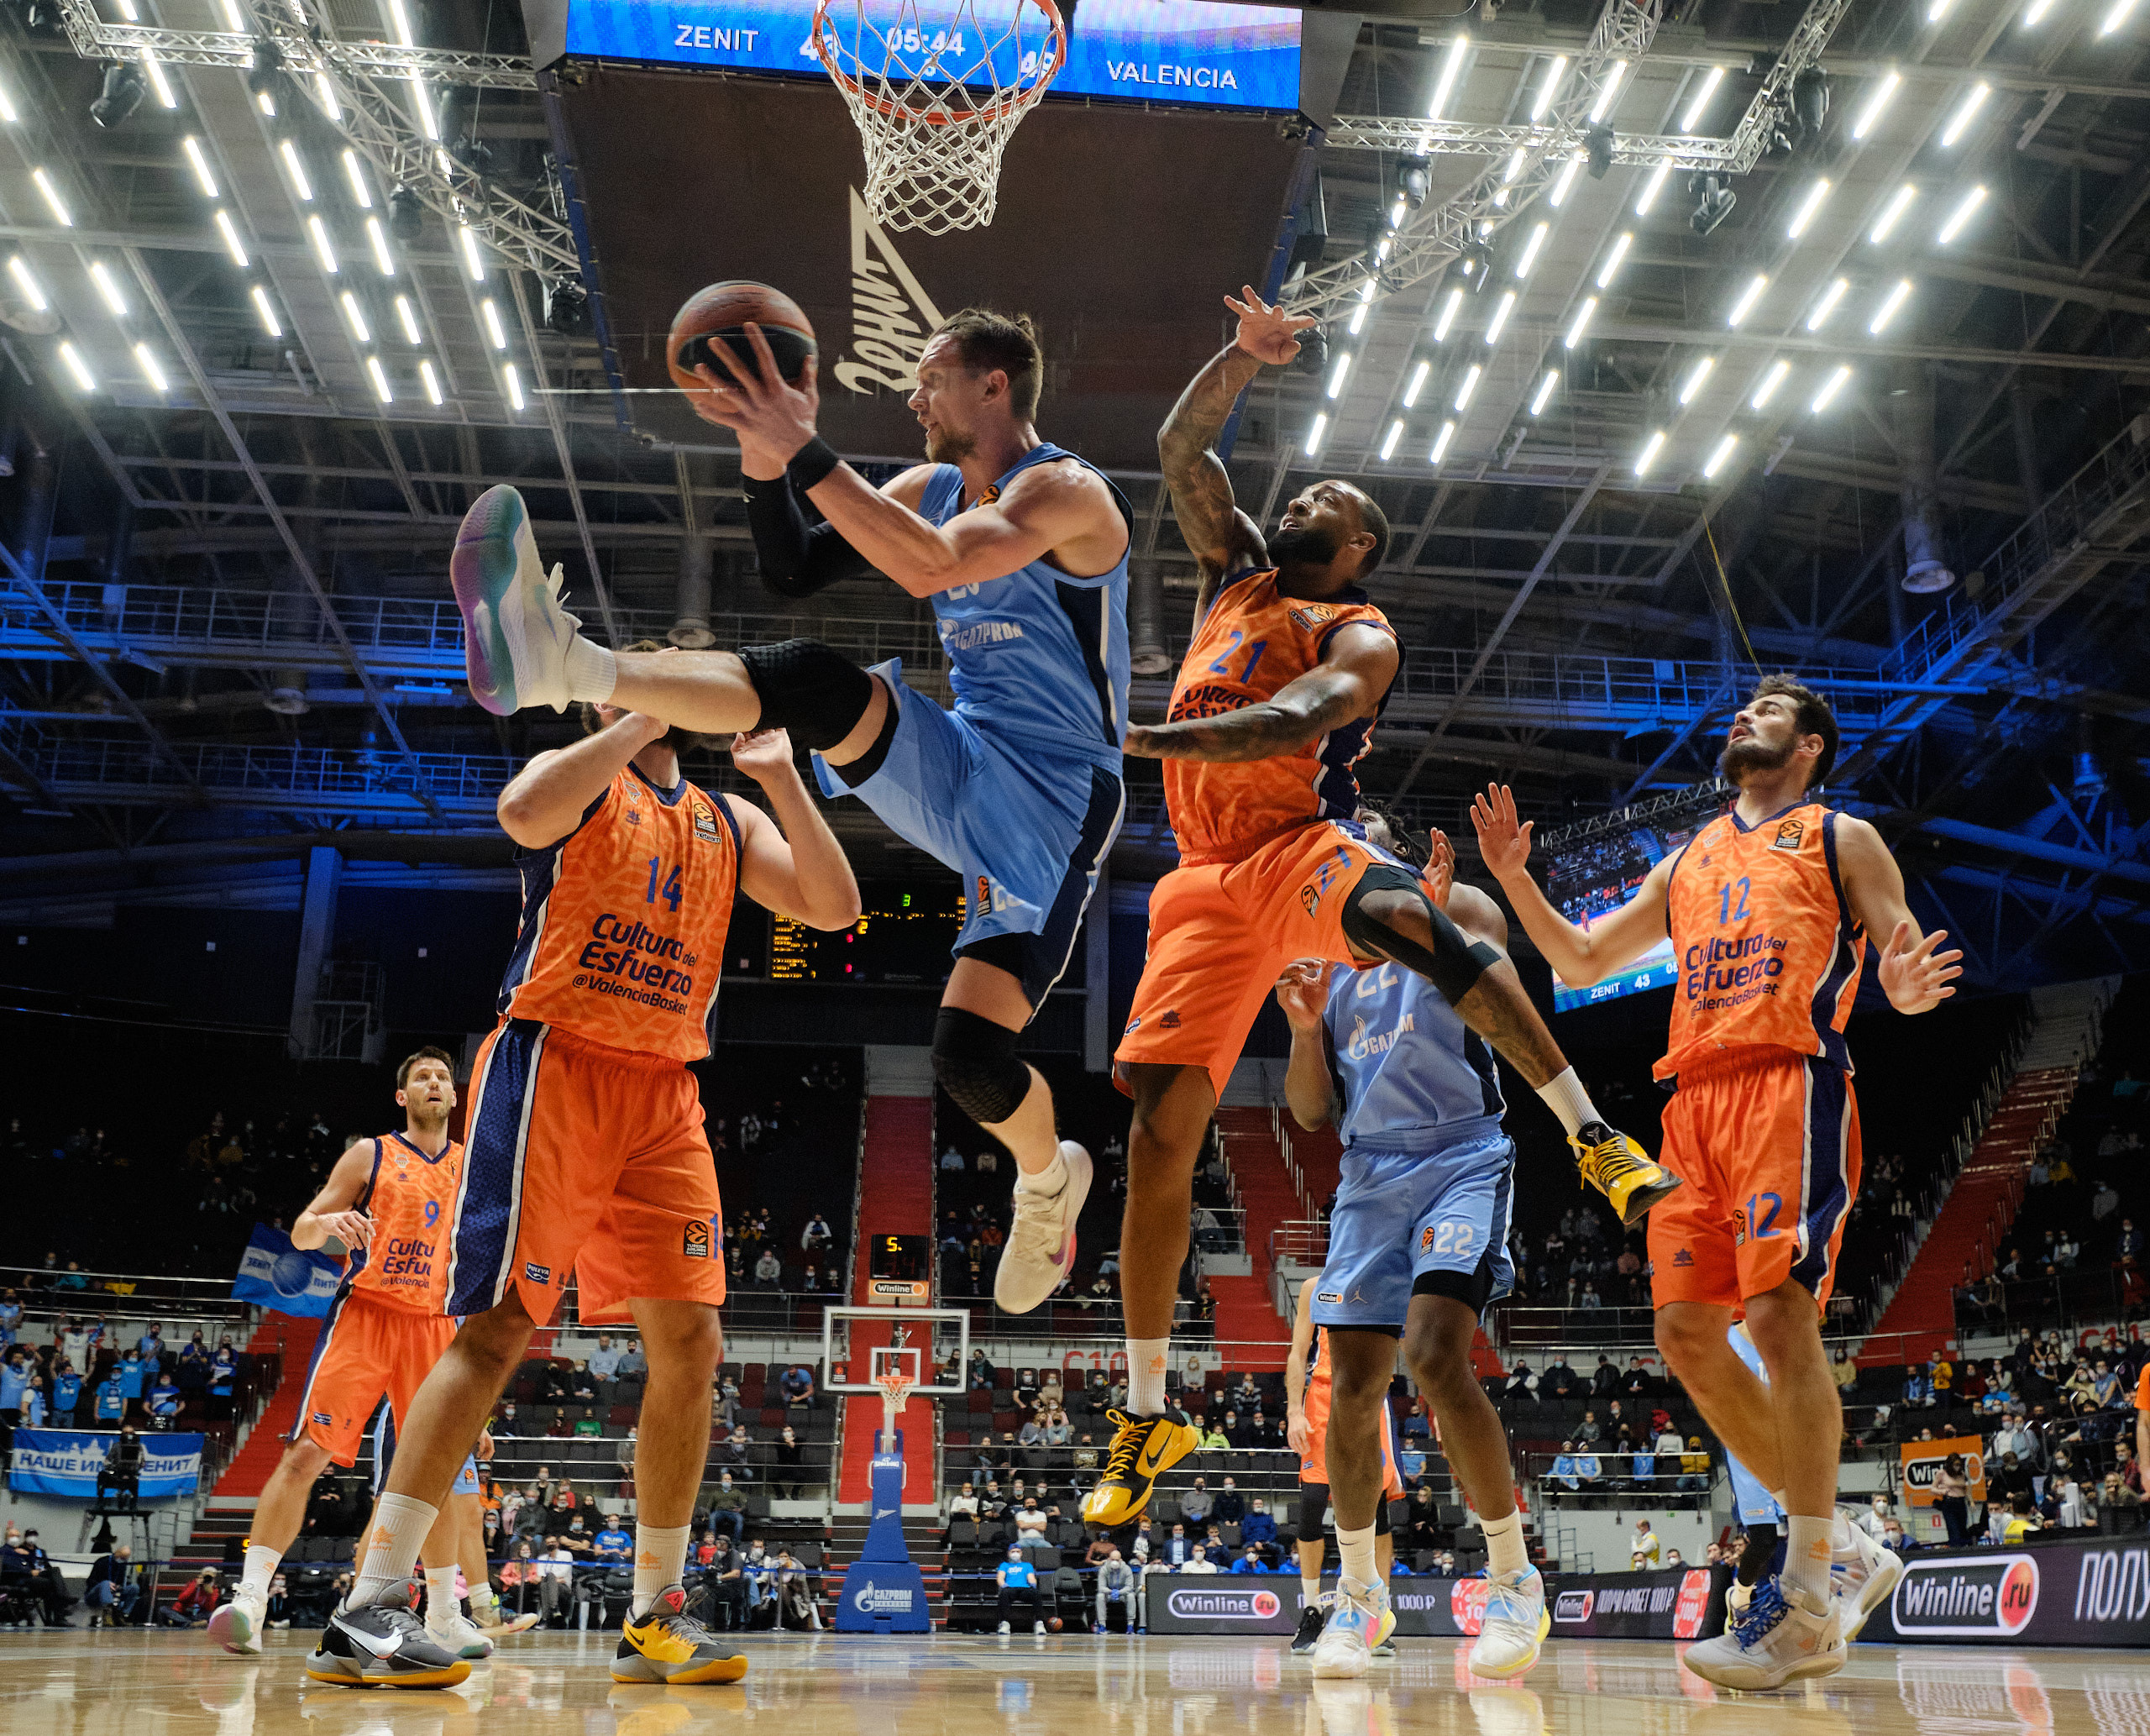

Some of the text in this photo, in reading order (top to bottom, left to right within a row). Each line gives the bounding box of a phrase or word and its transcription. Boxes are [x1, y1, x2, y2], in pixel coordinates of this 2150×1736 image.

[674, 24, 759, 52] ZENIT
[887, 27, 966, 56] 05:44
[1107, 60, 1239, 90] VALENCIA
[1209, 631, 1268, 684] 21
[646, 856, 682, 913] 14
[1719, 876, 1751, 925] 12
[592, 913, 699, 967] Cultura del
[1764, 936, 1788, 951] del
[579, 941, 693, 997] Esfuerzo
[1687, 957, 1785, 1000] Efuerzo
[572, 974, 689, 1015] @ValenciaBasket
[1591, 982, 1621, 999] ZENIT
[1634, 973, 1651, 989] 43
[424, 1200, 440, 1230] 9
[1745, 1192, 1783, 1240] 12
[388, 1238, 435, 1257] Cultu
[709, 1213, 724, 1260] 1
[1434, 1222, 1474, 1256] 22
[527, 1264, 549, 1275] PULEVA
[878, 1284, 910, 1293] Winline
[19, 1452, 77, 1471] НАШЕ
[144, 1458, 193, 1472] ЕНИТ
[874, 1589, 913, 1601] GAZPROM
[1178, 1596, 1277, 1613] Winline .ru
[1397, 1594, 1424, 1610] 1000
[1905, 1576, 2032, 1617] Winline .ru
